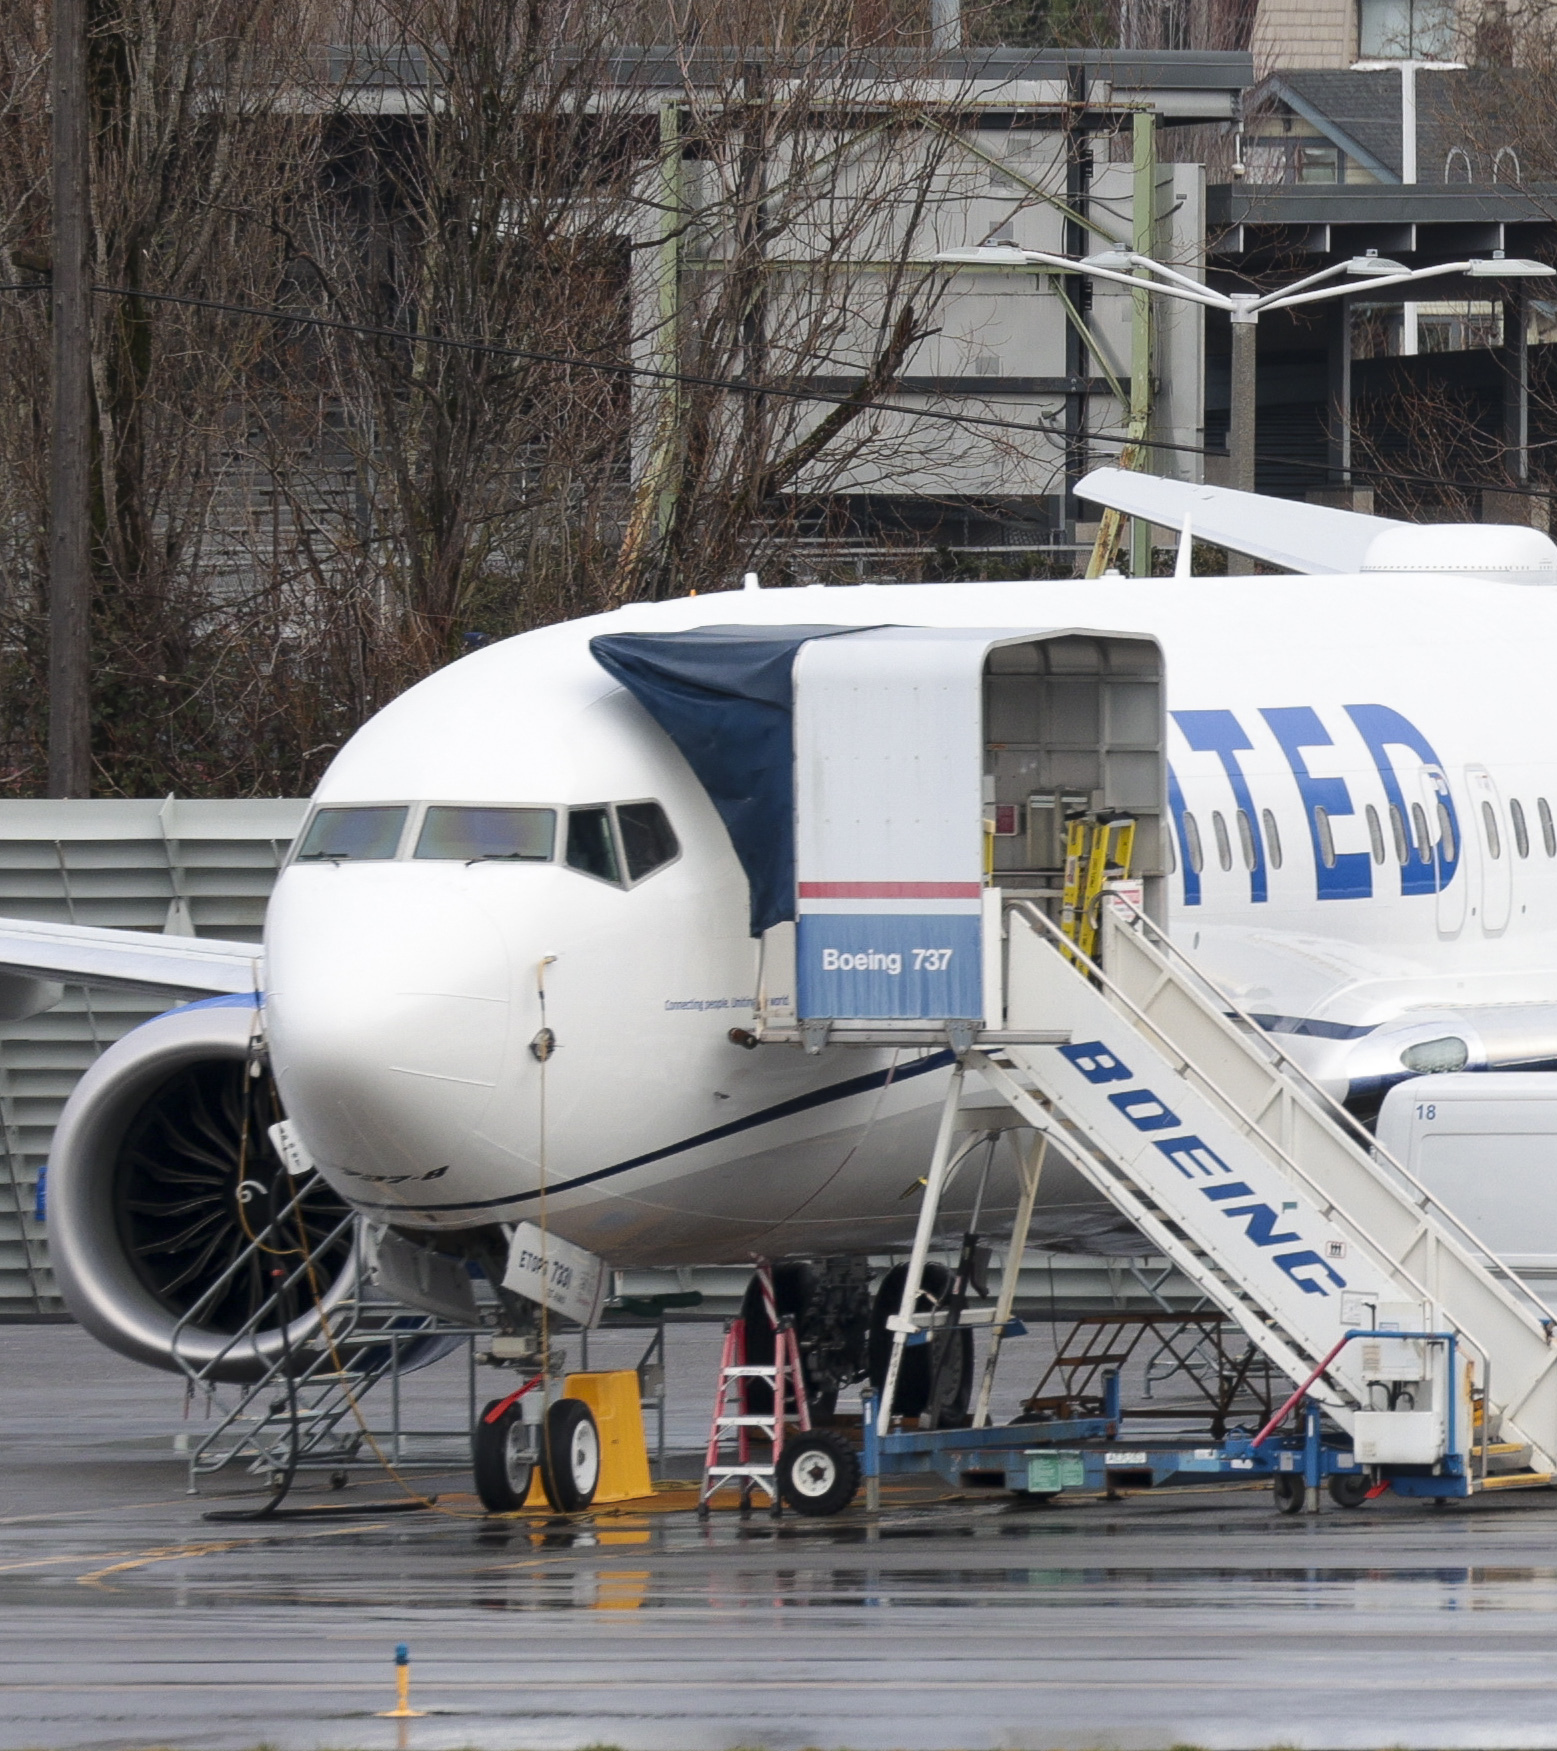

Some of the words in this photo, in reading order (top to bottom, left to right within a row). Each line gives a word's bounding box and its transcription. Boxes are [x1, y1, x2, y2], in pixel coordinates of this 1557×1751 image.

[822, 949, 902, 975] Boeing
[911, 949, 953, 971] 737
[1416, 1104, 1436, 1120] 18
[1055, 1040, 1347, 1297] BOEING
